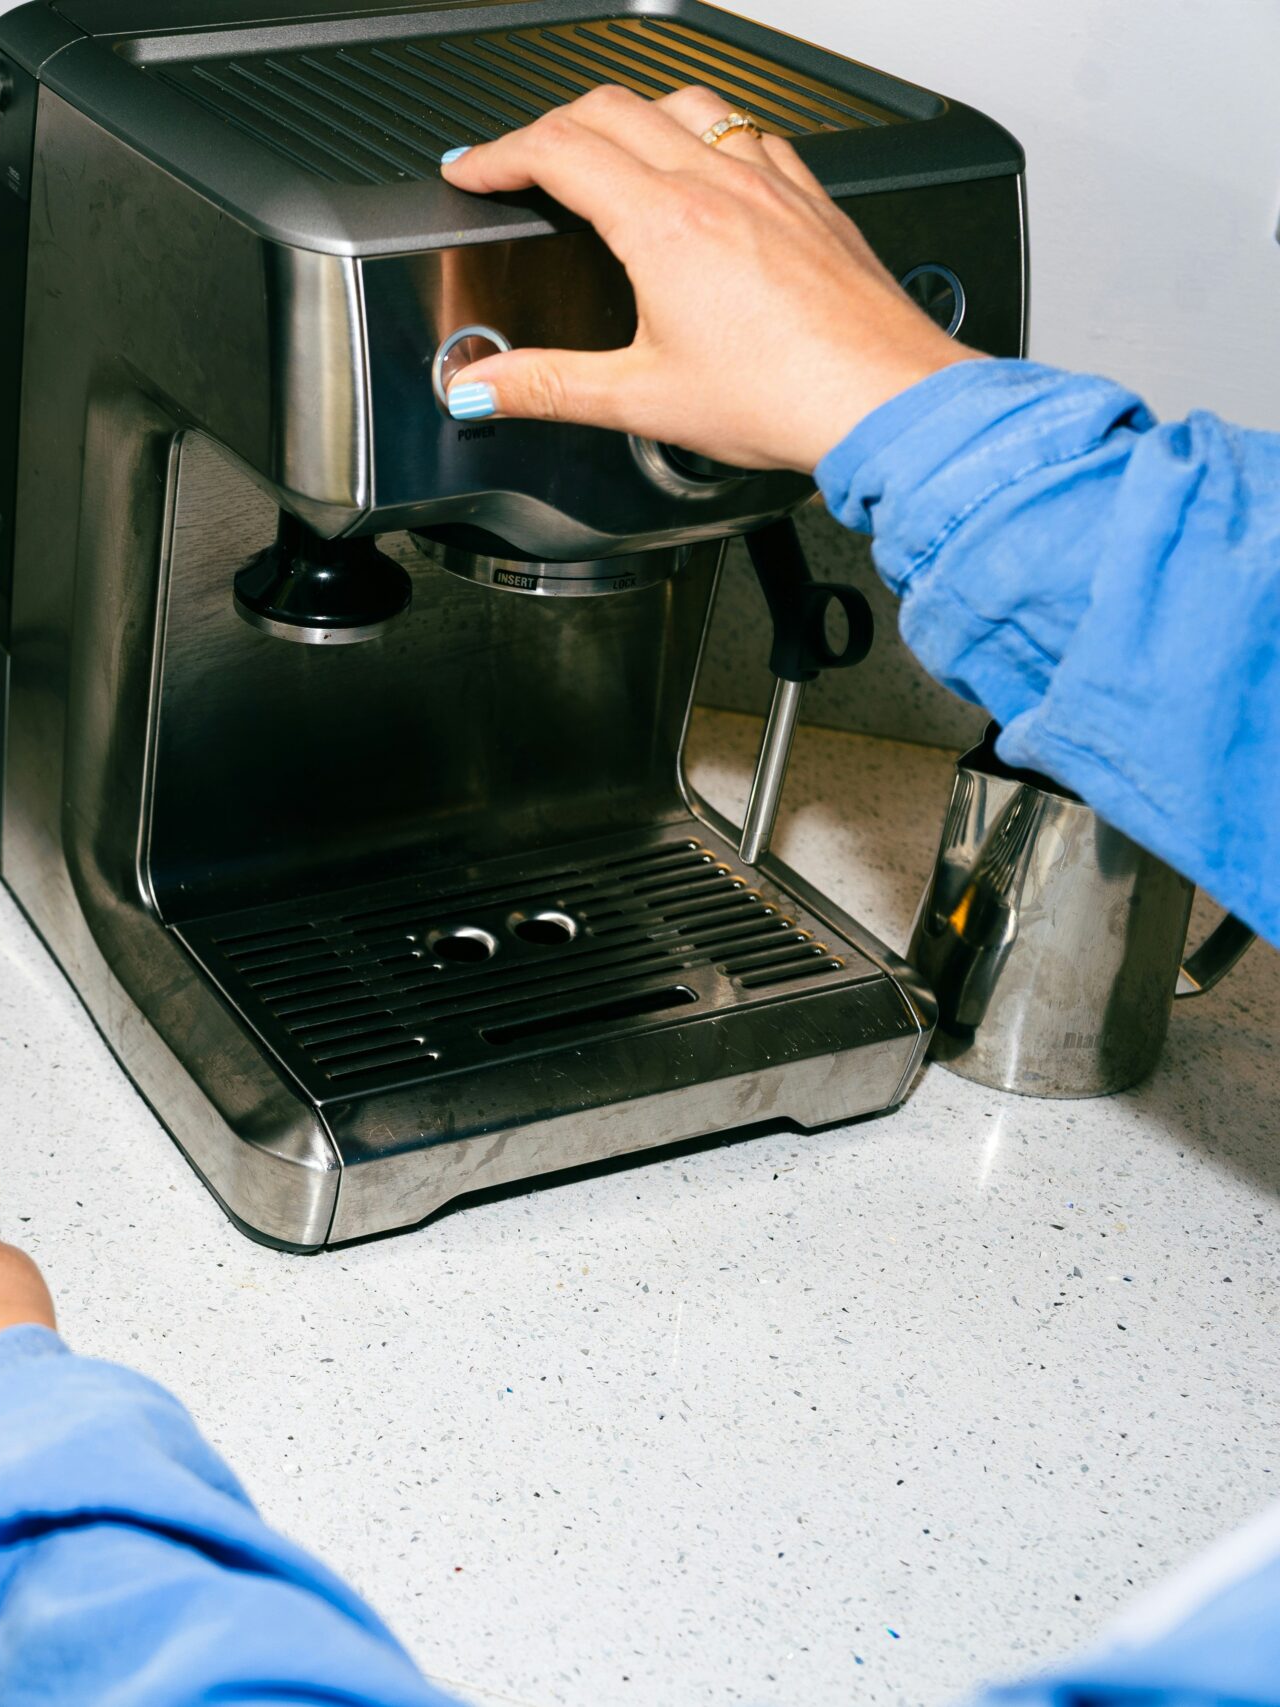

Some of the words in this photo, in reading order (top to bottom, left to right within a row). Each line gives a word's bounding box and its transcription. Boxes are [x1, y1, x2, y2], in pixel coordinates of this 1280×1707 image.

[457, 425, 496, 442] POWER
[497, 572, 535, 588] INSERT
[612, 578, 637, 590] LOCK
